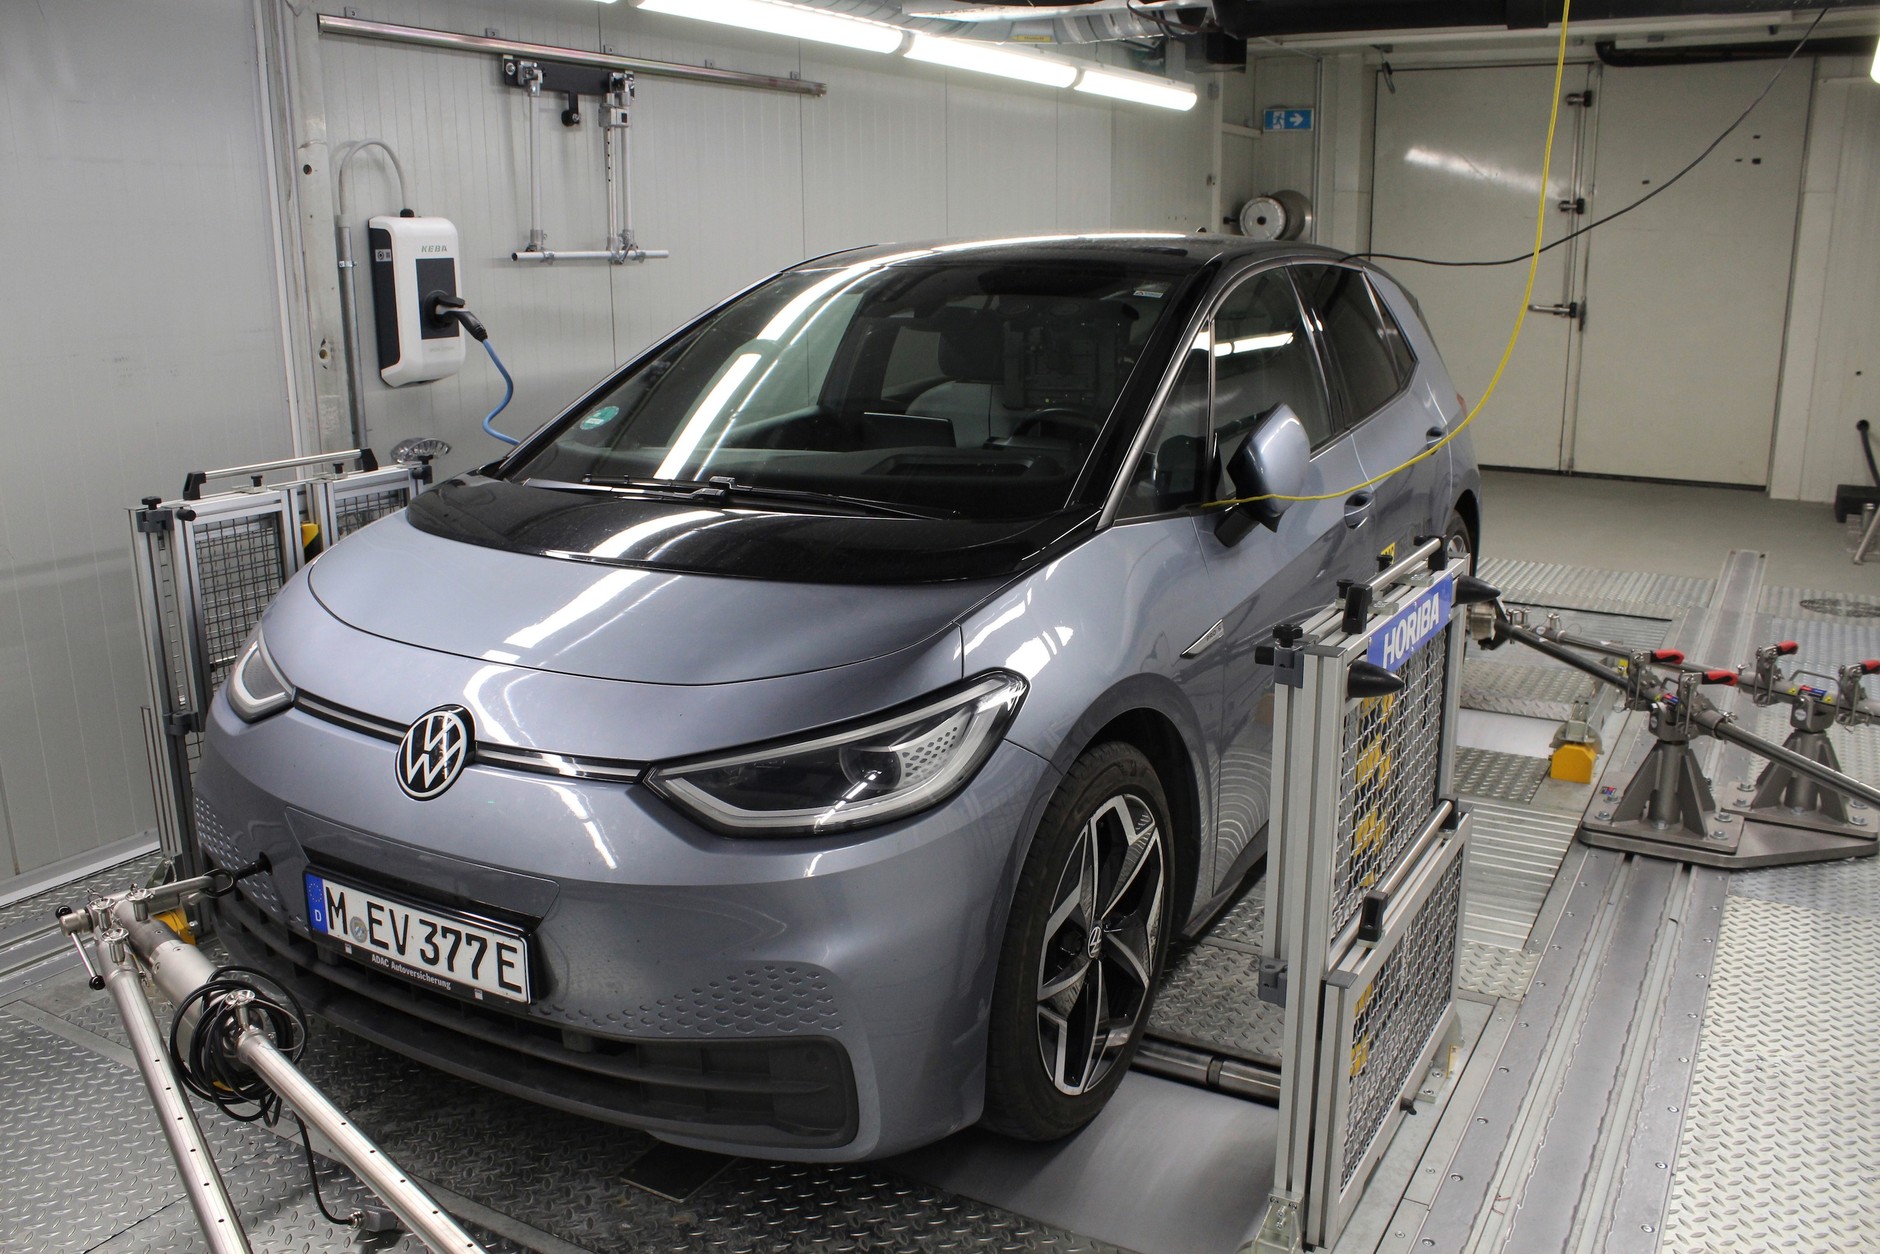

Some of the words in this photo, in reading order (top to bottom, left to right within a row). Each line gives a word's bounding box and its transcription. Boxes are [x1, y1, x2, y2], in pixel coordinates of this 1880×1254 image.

[421, 245, 448, 253] KEBA
[1382, 592, 1440, 669] HORIBA
[314, 908, 322, 923] D
[325, 886, 349, 935] M
[366, 900, 409, 956] EV
[419, 918, 523, 994] 377E
[371, 953, 390, 967] ADAC
[391, 961, 452, 991] Autoversicherung
